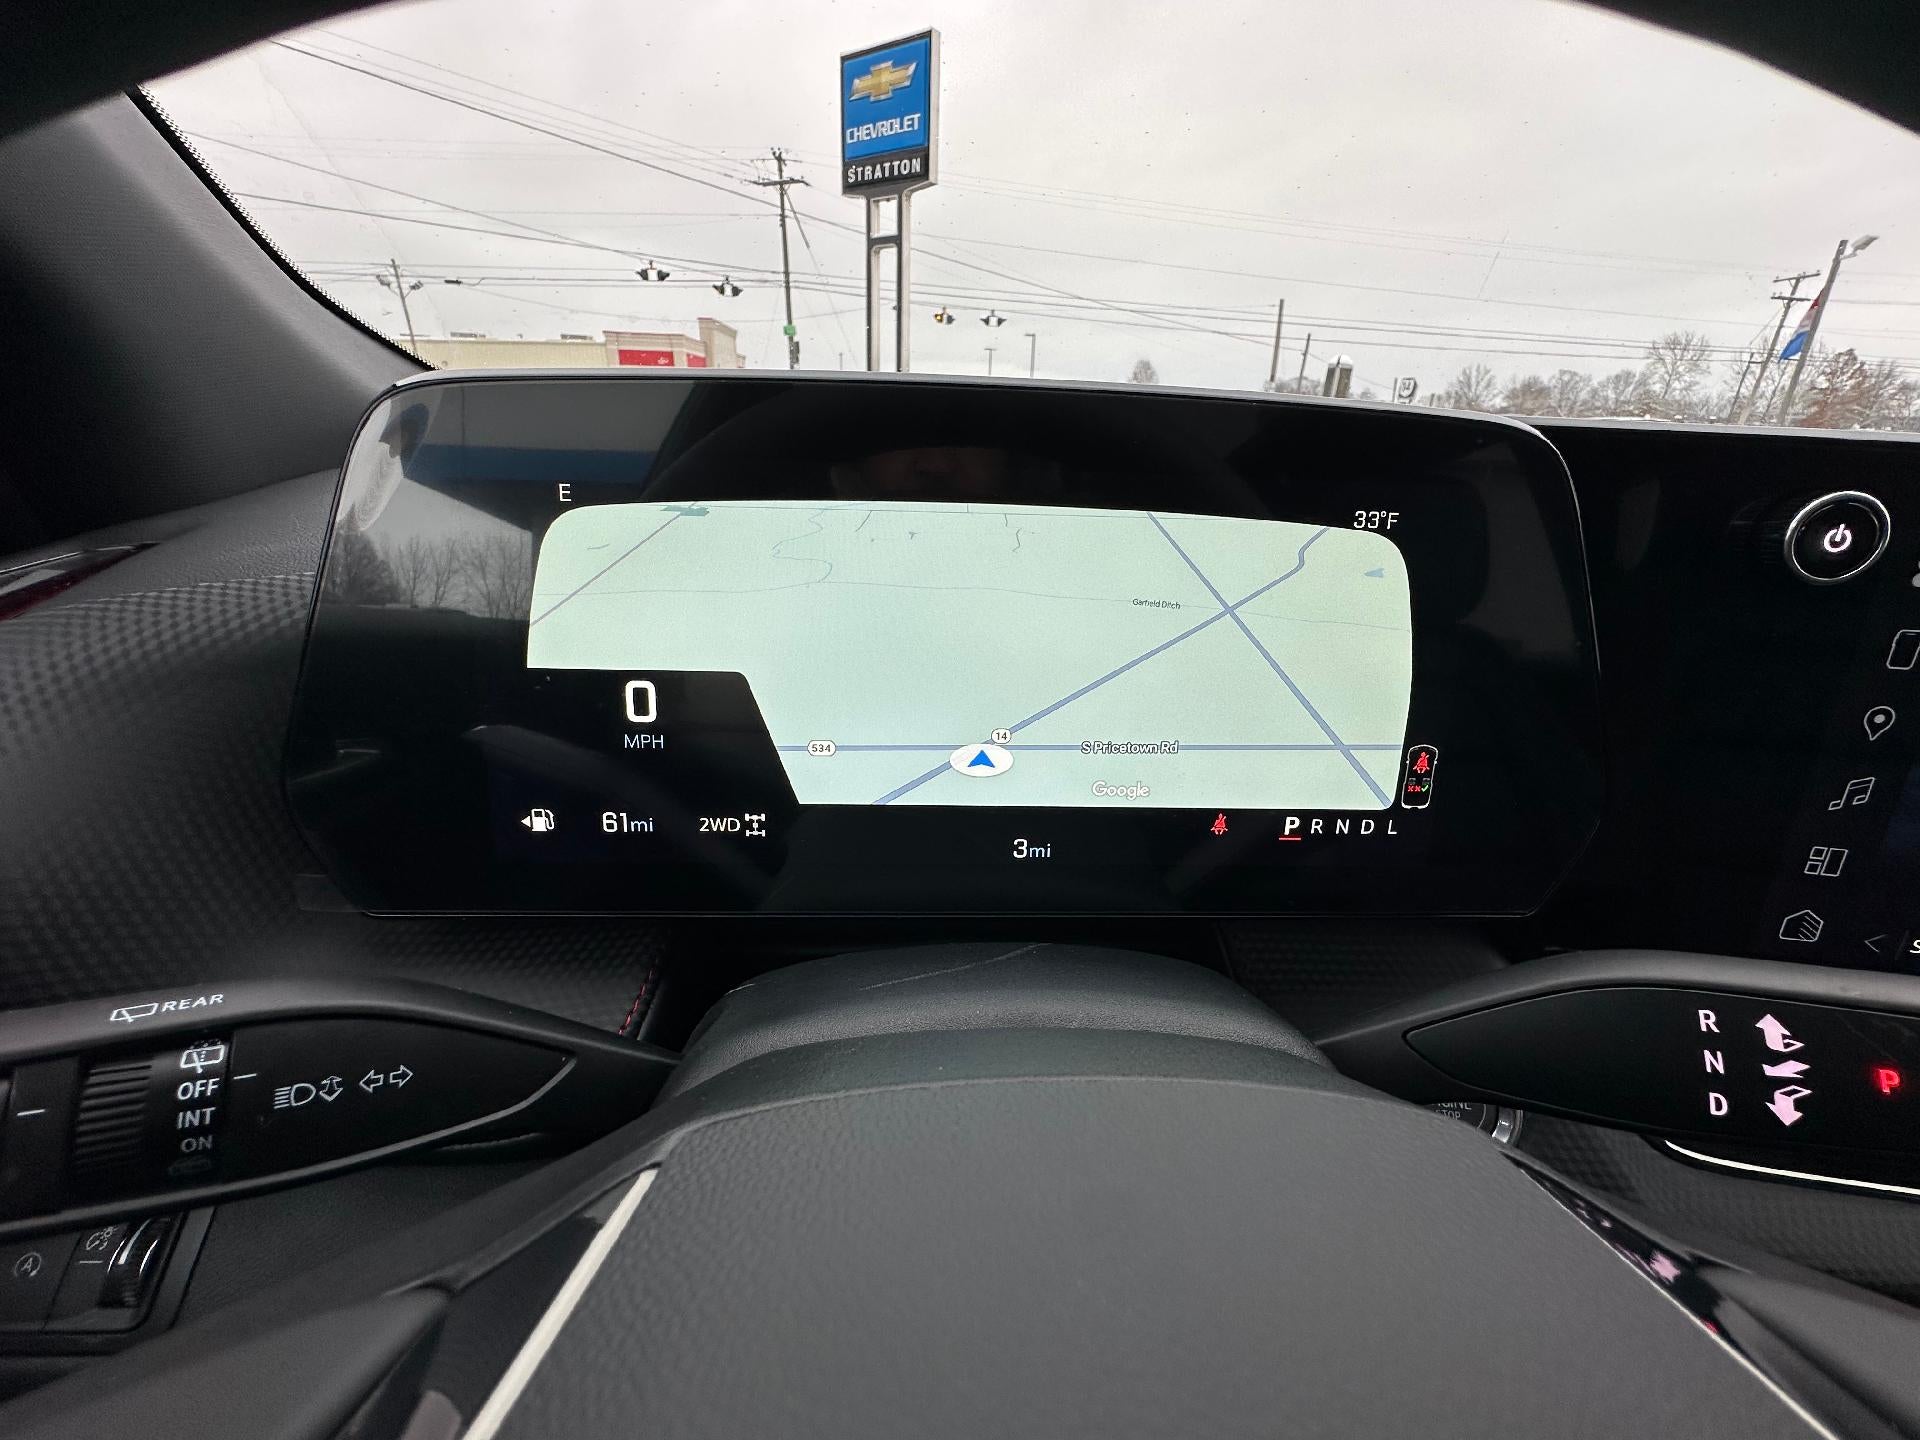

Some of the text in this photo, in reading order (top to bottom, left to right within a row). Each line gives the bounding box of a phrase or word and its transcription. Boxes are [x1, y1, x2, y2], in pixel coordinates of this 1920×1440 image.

[846, 113, 921, 144] CHEVROLET
[847, 157, 921, 183] STRATTON
[559, 483, 572, 502] E
[1353, 510, 1400, 530] 33°F
[625, 680, 657, 723] 0
[624, 733, 664, 749] MPH
[995, 731, 1008, 742] 14
[811, 742, 832, 754] 534
[1081, 739, 1179, 755] S Pricetown Rd
[1092, 780, 1151, 801] Google
[699, 817, 741, 833] 2WD
[1283, 816, 1398, 836] P R N D L
[161, 993, 224, 1013] REAR
[1698, 1009, 1720, 1033] R
[1703, 1049, 1725, 1075] N
[177, 1077, 220, 1101] OFF
[1879, 1068, 1901, 1094] P
[1708, 1091, 1729, 1116] D
[176, 1106, 217, 1129] INT
[181, 1135, 213, 1153] ON
